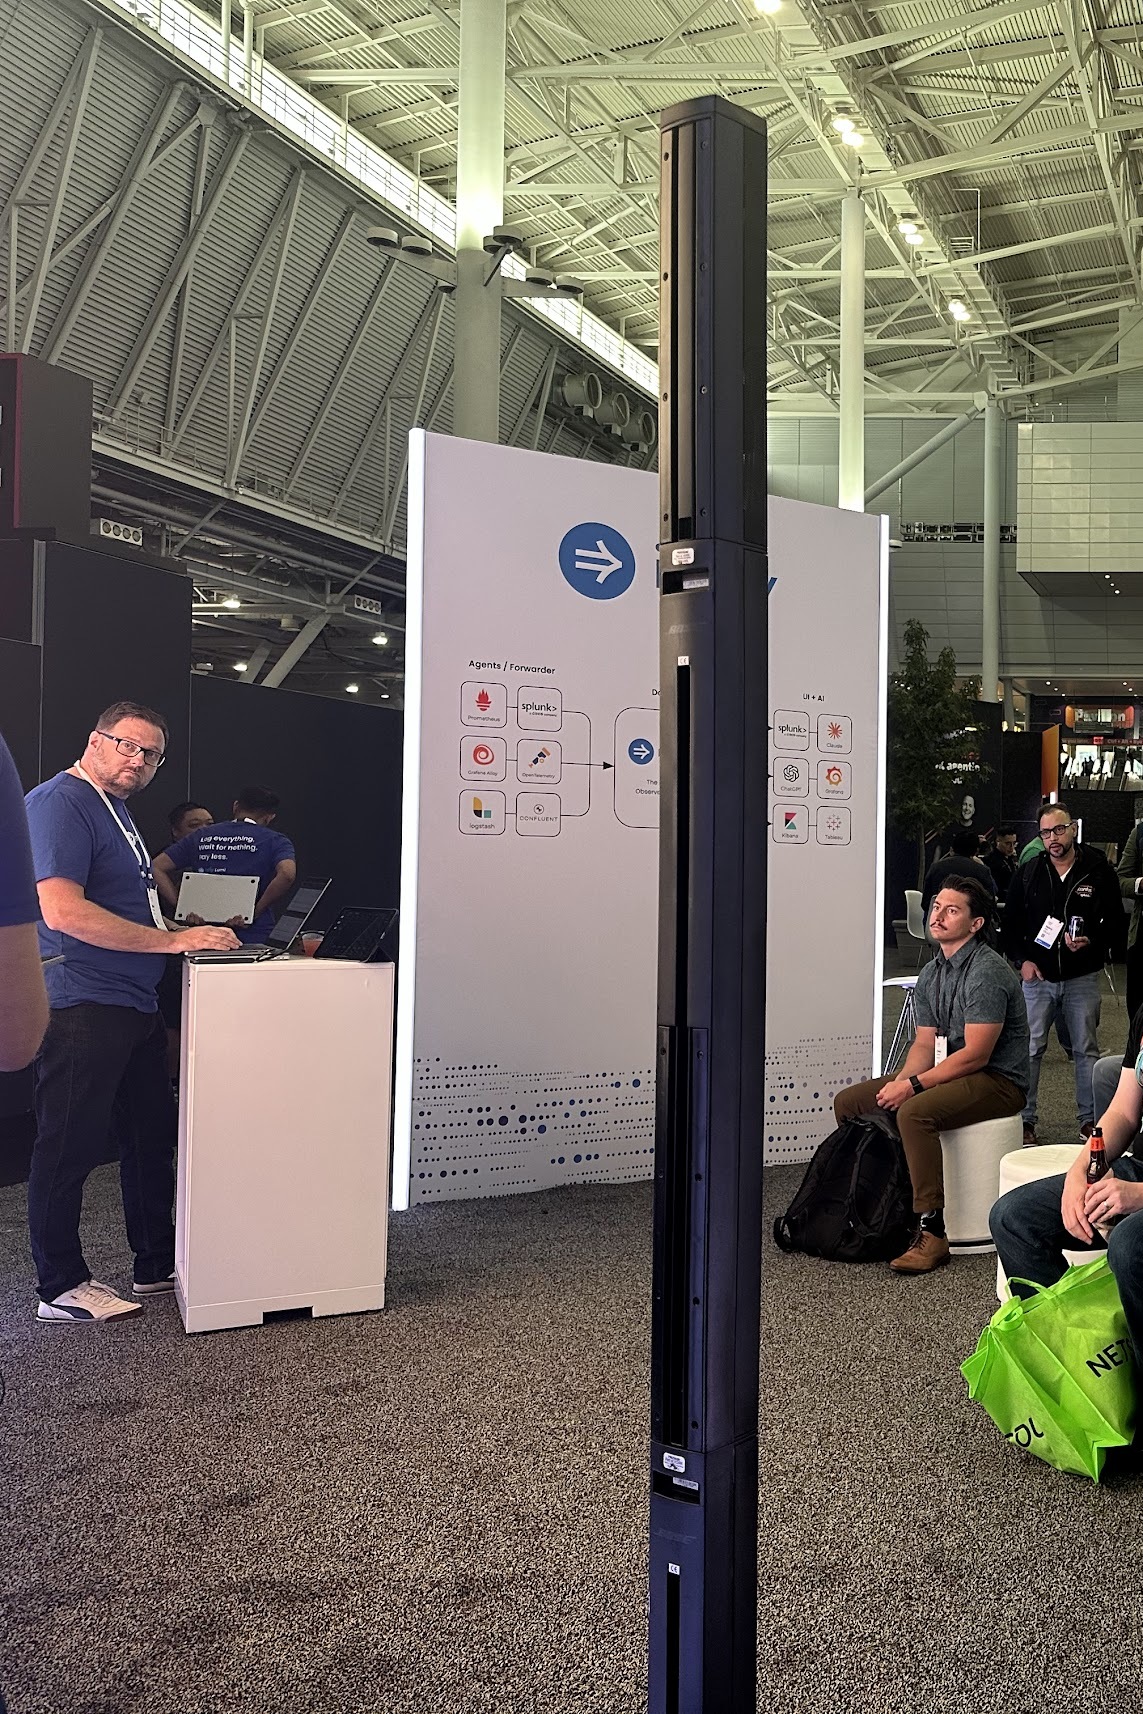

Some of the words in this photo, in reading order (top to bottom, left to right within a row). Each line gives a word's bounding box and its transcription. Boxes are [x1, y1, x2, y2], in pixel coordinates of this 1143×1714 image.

[468, 660, 501, 670] Agents
[503, 661, 508, 671] /
[509, 663, 556, 674] Forwarder
